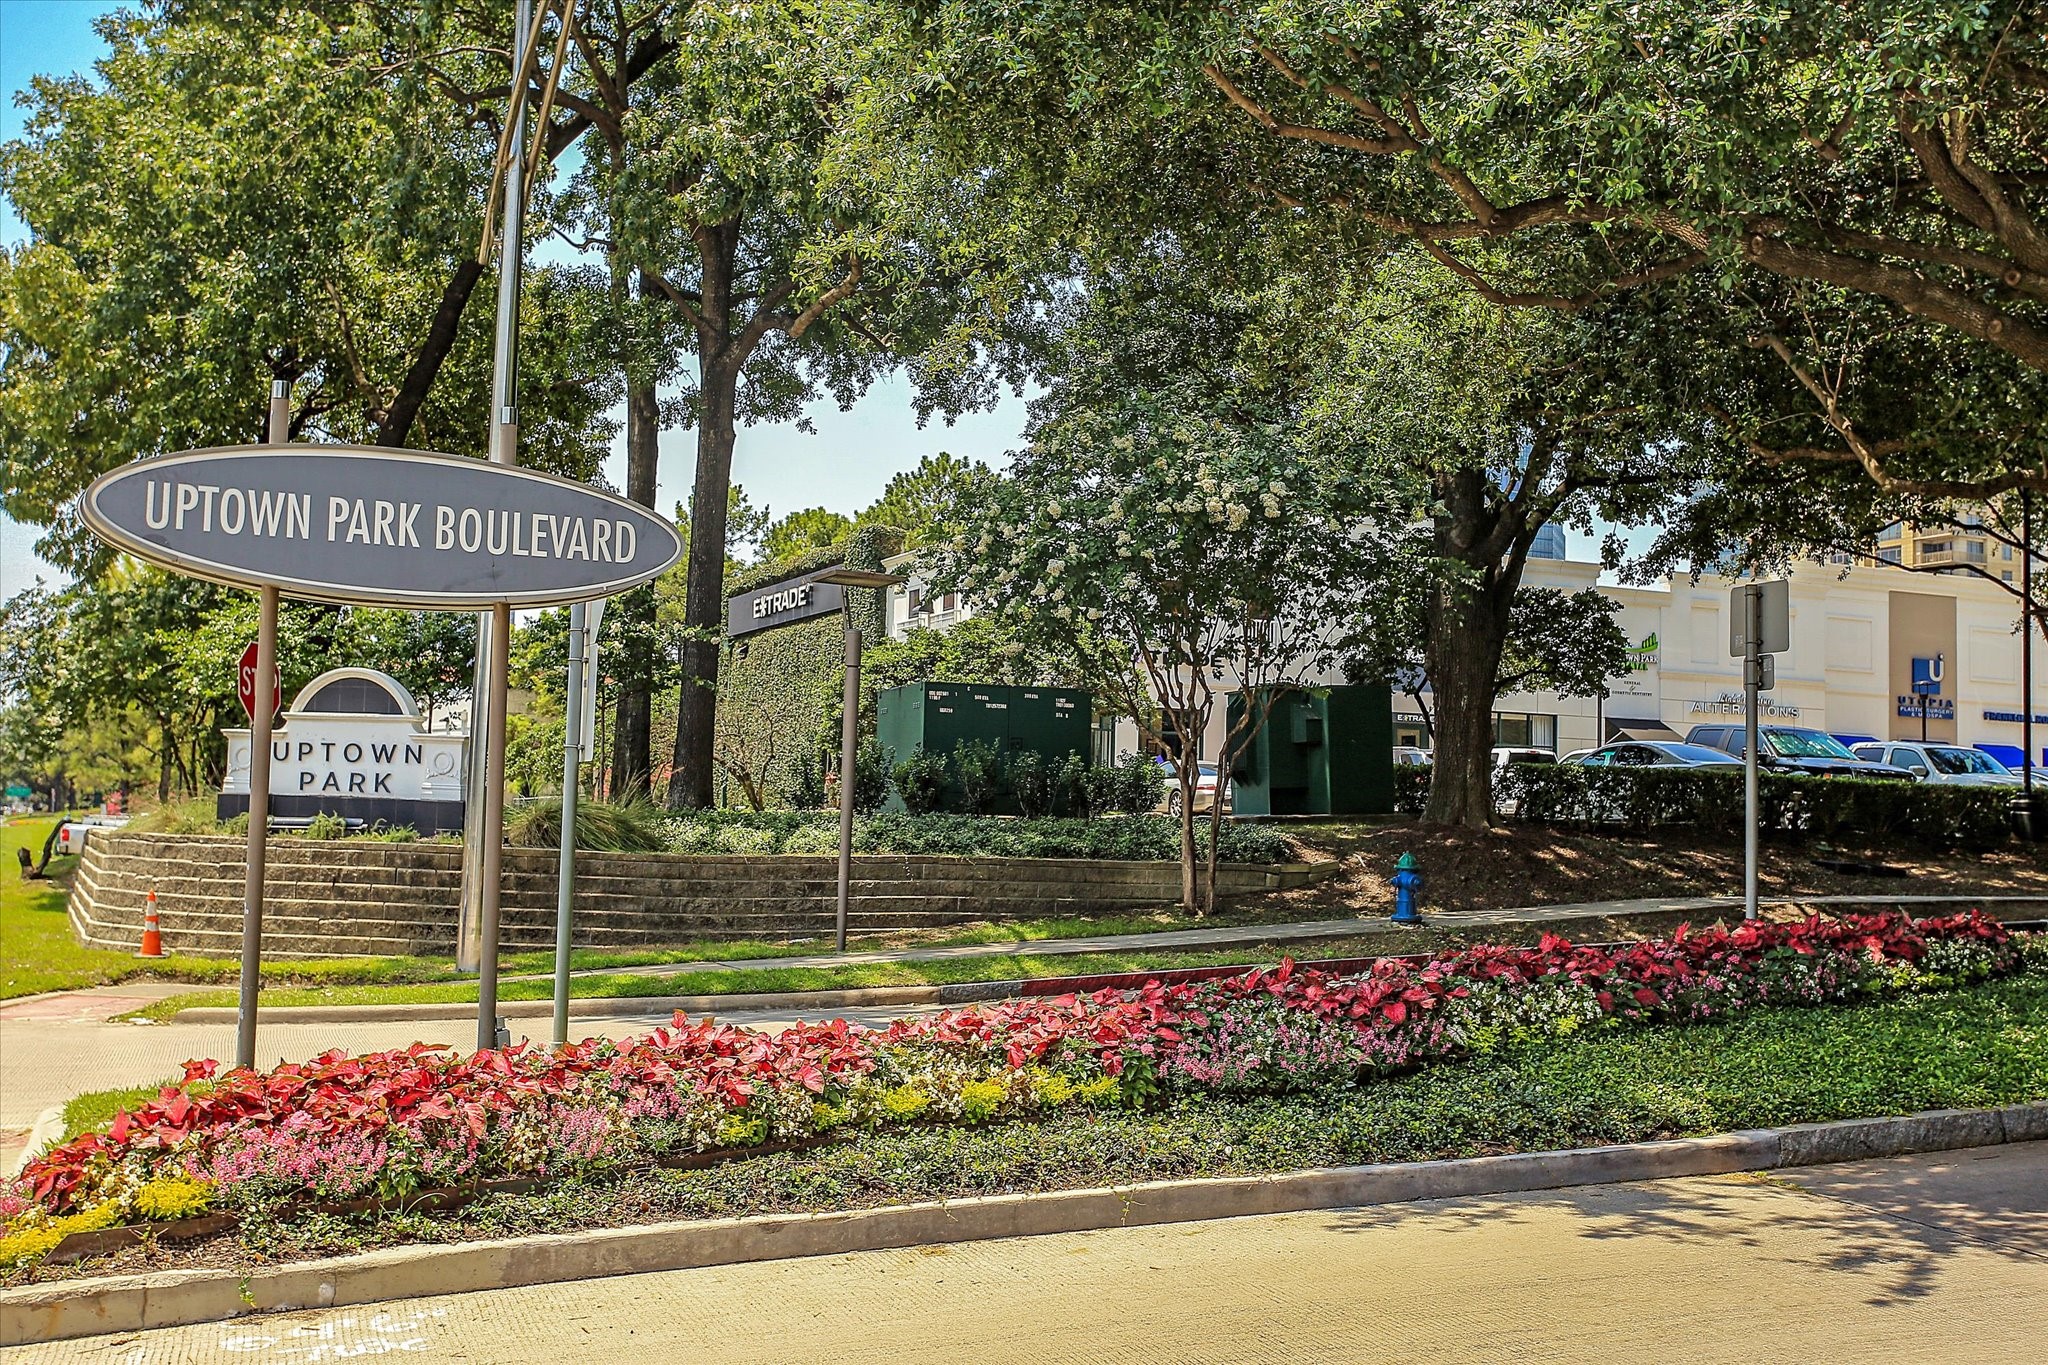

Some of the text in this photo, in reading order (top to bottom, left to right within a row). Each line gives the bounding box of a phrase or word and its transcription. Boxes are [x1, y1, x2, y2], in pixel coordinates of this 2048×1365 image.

[145, 480, 637, 564] UPTOWN PARK BOULEVARD
[273, 741, 423, 764] UPTOWN
[300, 771, 391, 793] PARK
